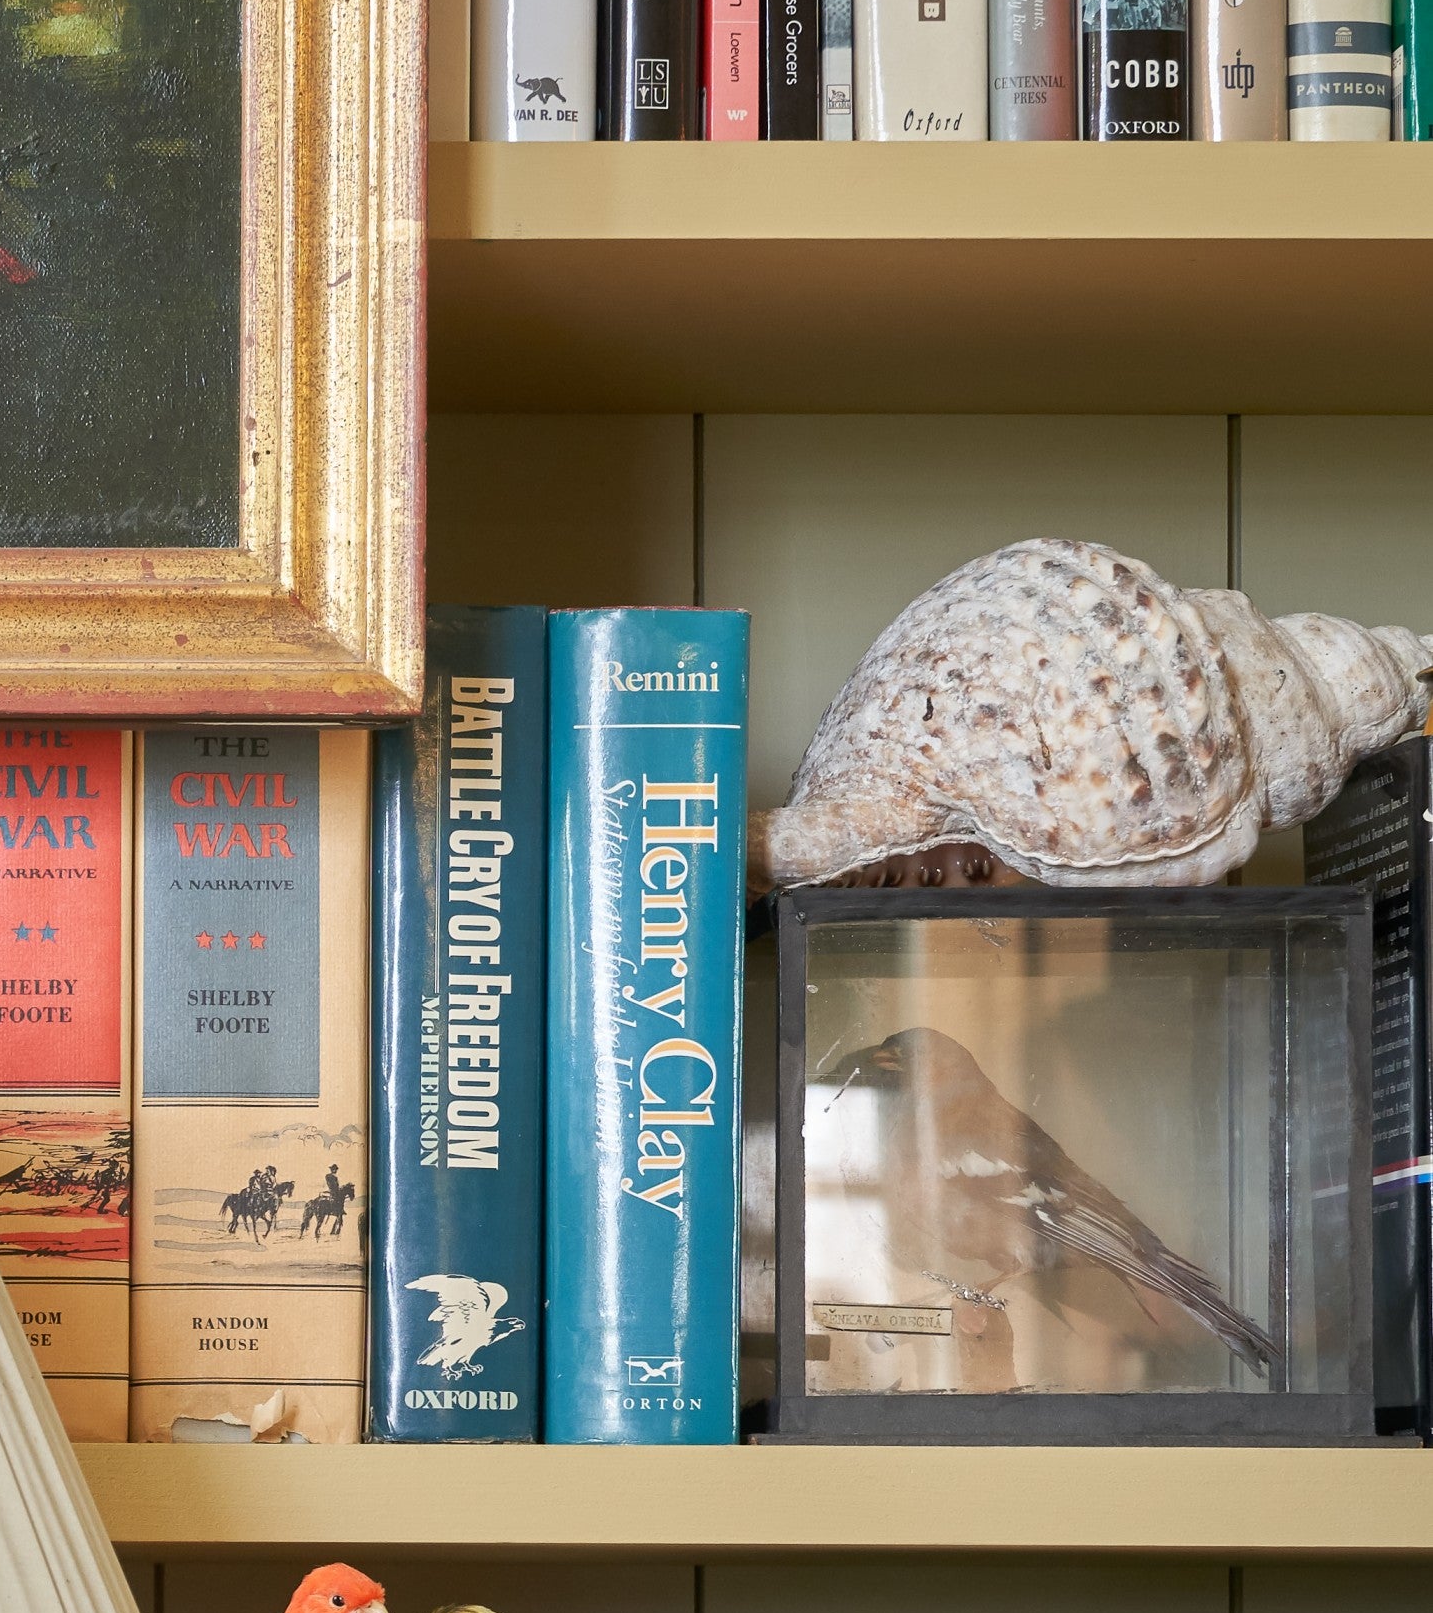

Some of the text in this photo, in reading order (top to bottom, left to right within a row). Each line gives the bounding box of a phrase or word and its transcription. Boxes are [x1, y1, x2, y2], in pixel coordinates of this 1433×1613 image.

[1106, 61, 1179, 88] COBB
[1296, 83, 1385, 96] PANTHEON
[1105, 120, 1180, 135] OXFORD
[603, 663, 720, 693] Remini
[194, 737, 270, 757] THE
[171, 773, 297, 808] CIVIL
[172, 823, 295, 860] WAR
[169, 879, 294, 892] A NARRATIVE
[187, 989, 275, 1010] SHELBY
[621, 773, 719, 1221] Henry Clay
[195, 1015, 271, 1035] FOOTE
[192, 1317, 269, 1332] RANDOM
[199, 1338, 259, 1351] HOUSE
[404, 1391, 518, 1412] OXFORD
